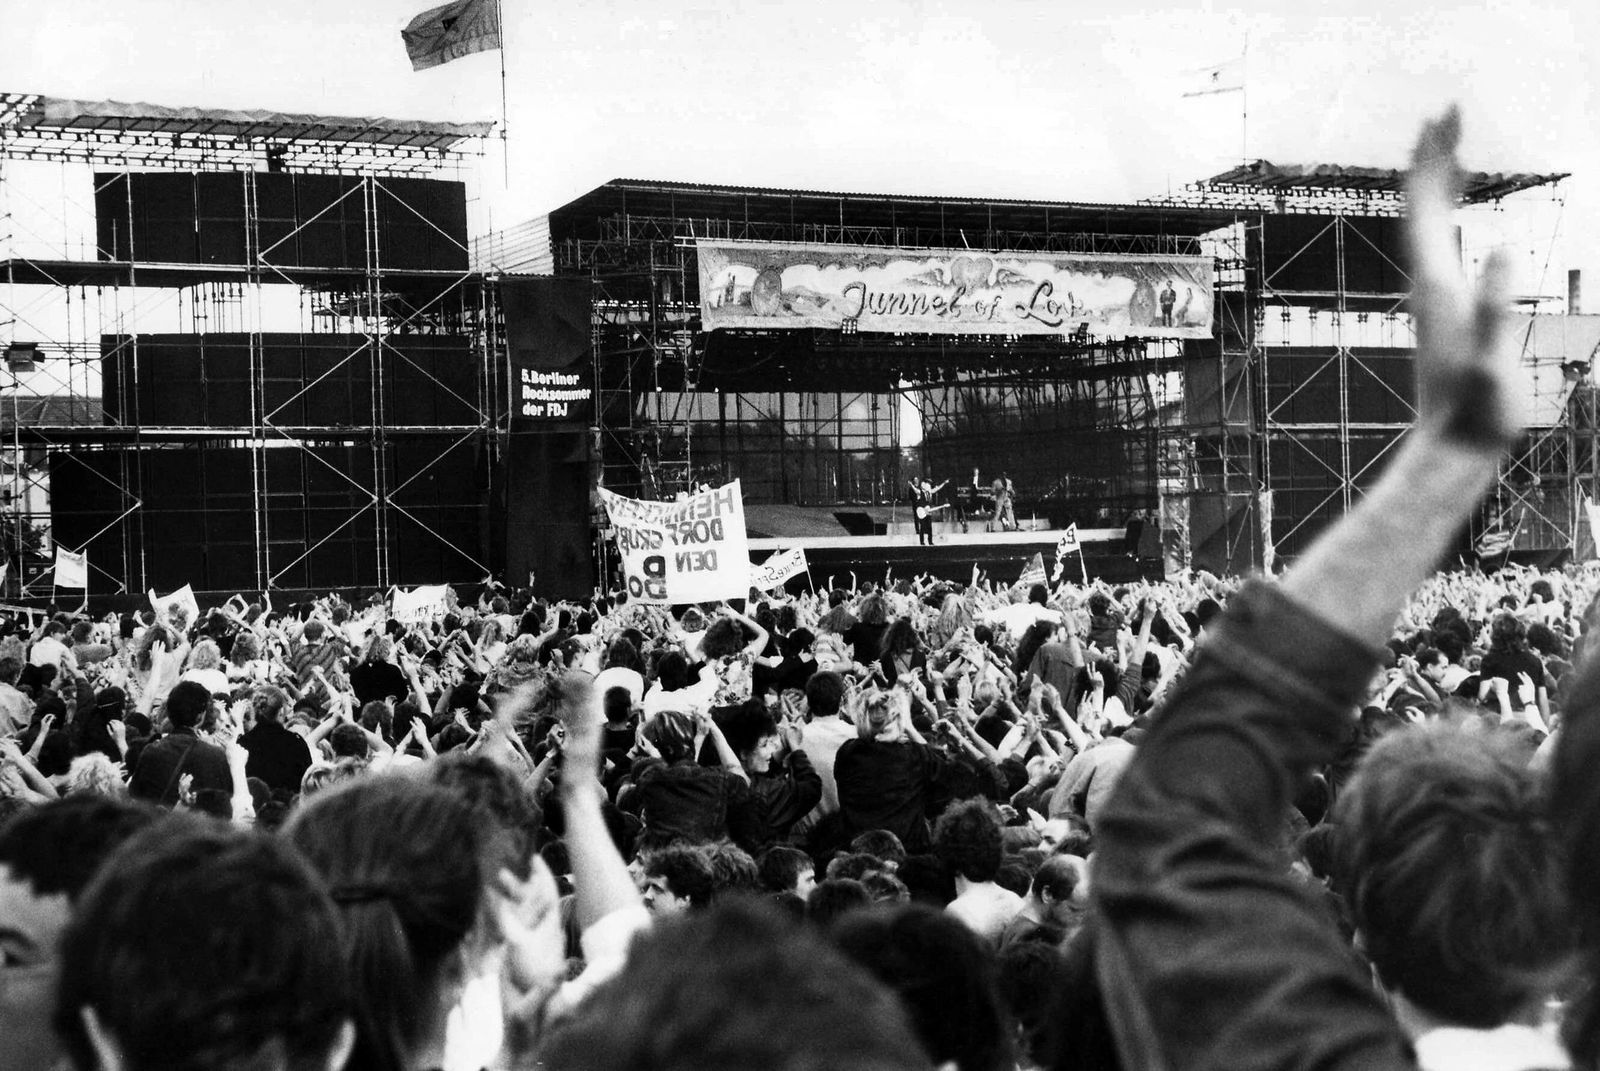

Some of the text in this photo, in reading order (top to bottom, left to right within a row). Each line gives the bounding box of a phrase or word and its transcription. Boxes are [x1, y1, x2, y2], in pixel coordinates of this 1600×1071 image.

[841, 281, 966, 318] Tunnel
[975, 295, 1002, 320] of
[522, 384, 591, 401] Rocksommer
[522, 401, 568, 417] der FDJ
